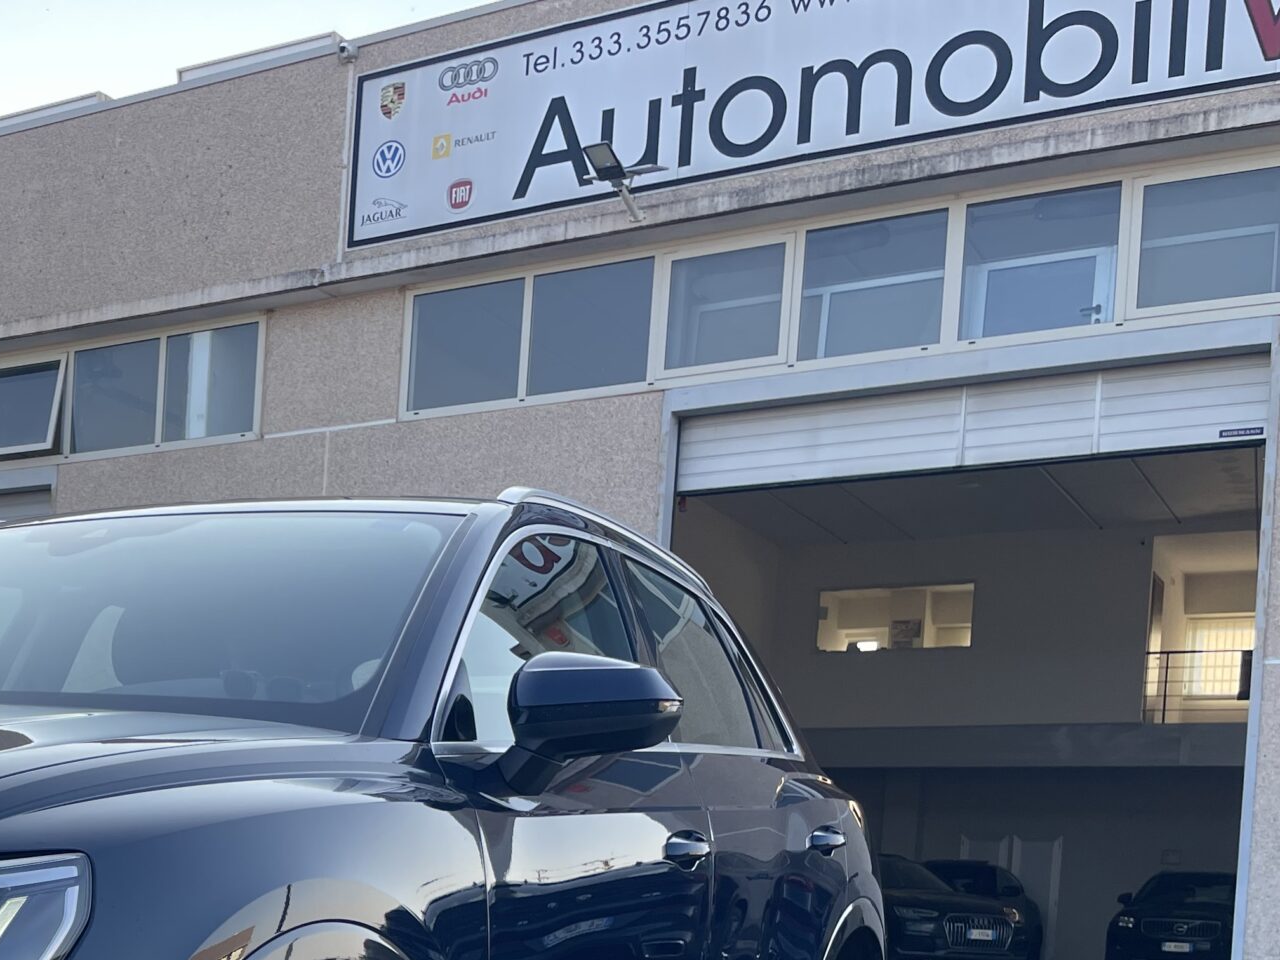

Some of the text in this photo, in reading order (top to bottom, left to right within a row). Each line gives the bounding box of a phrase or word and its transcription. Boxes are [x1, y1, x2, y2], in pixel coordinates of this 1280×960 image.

[522, 0, 772, 76] Tel.333.3557836
[446, 88, 488, 106] Audi
[454, 131, 496, 148] RENAULT
[451, 184, 472, 206] FIAT
[361, 208, 401, 226] JAGUAR
